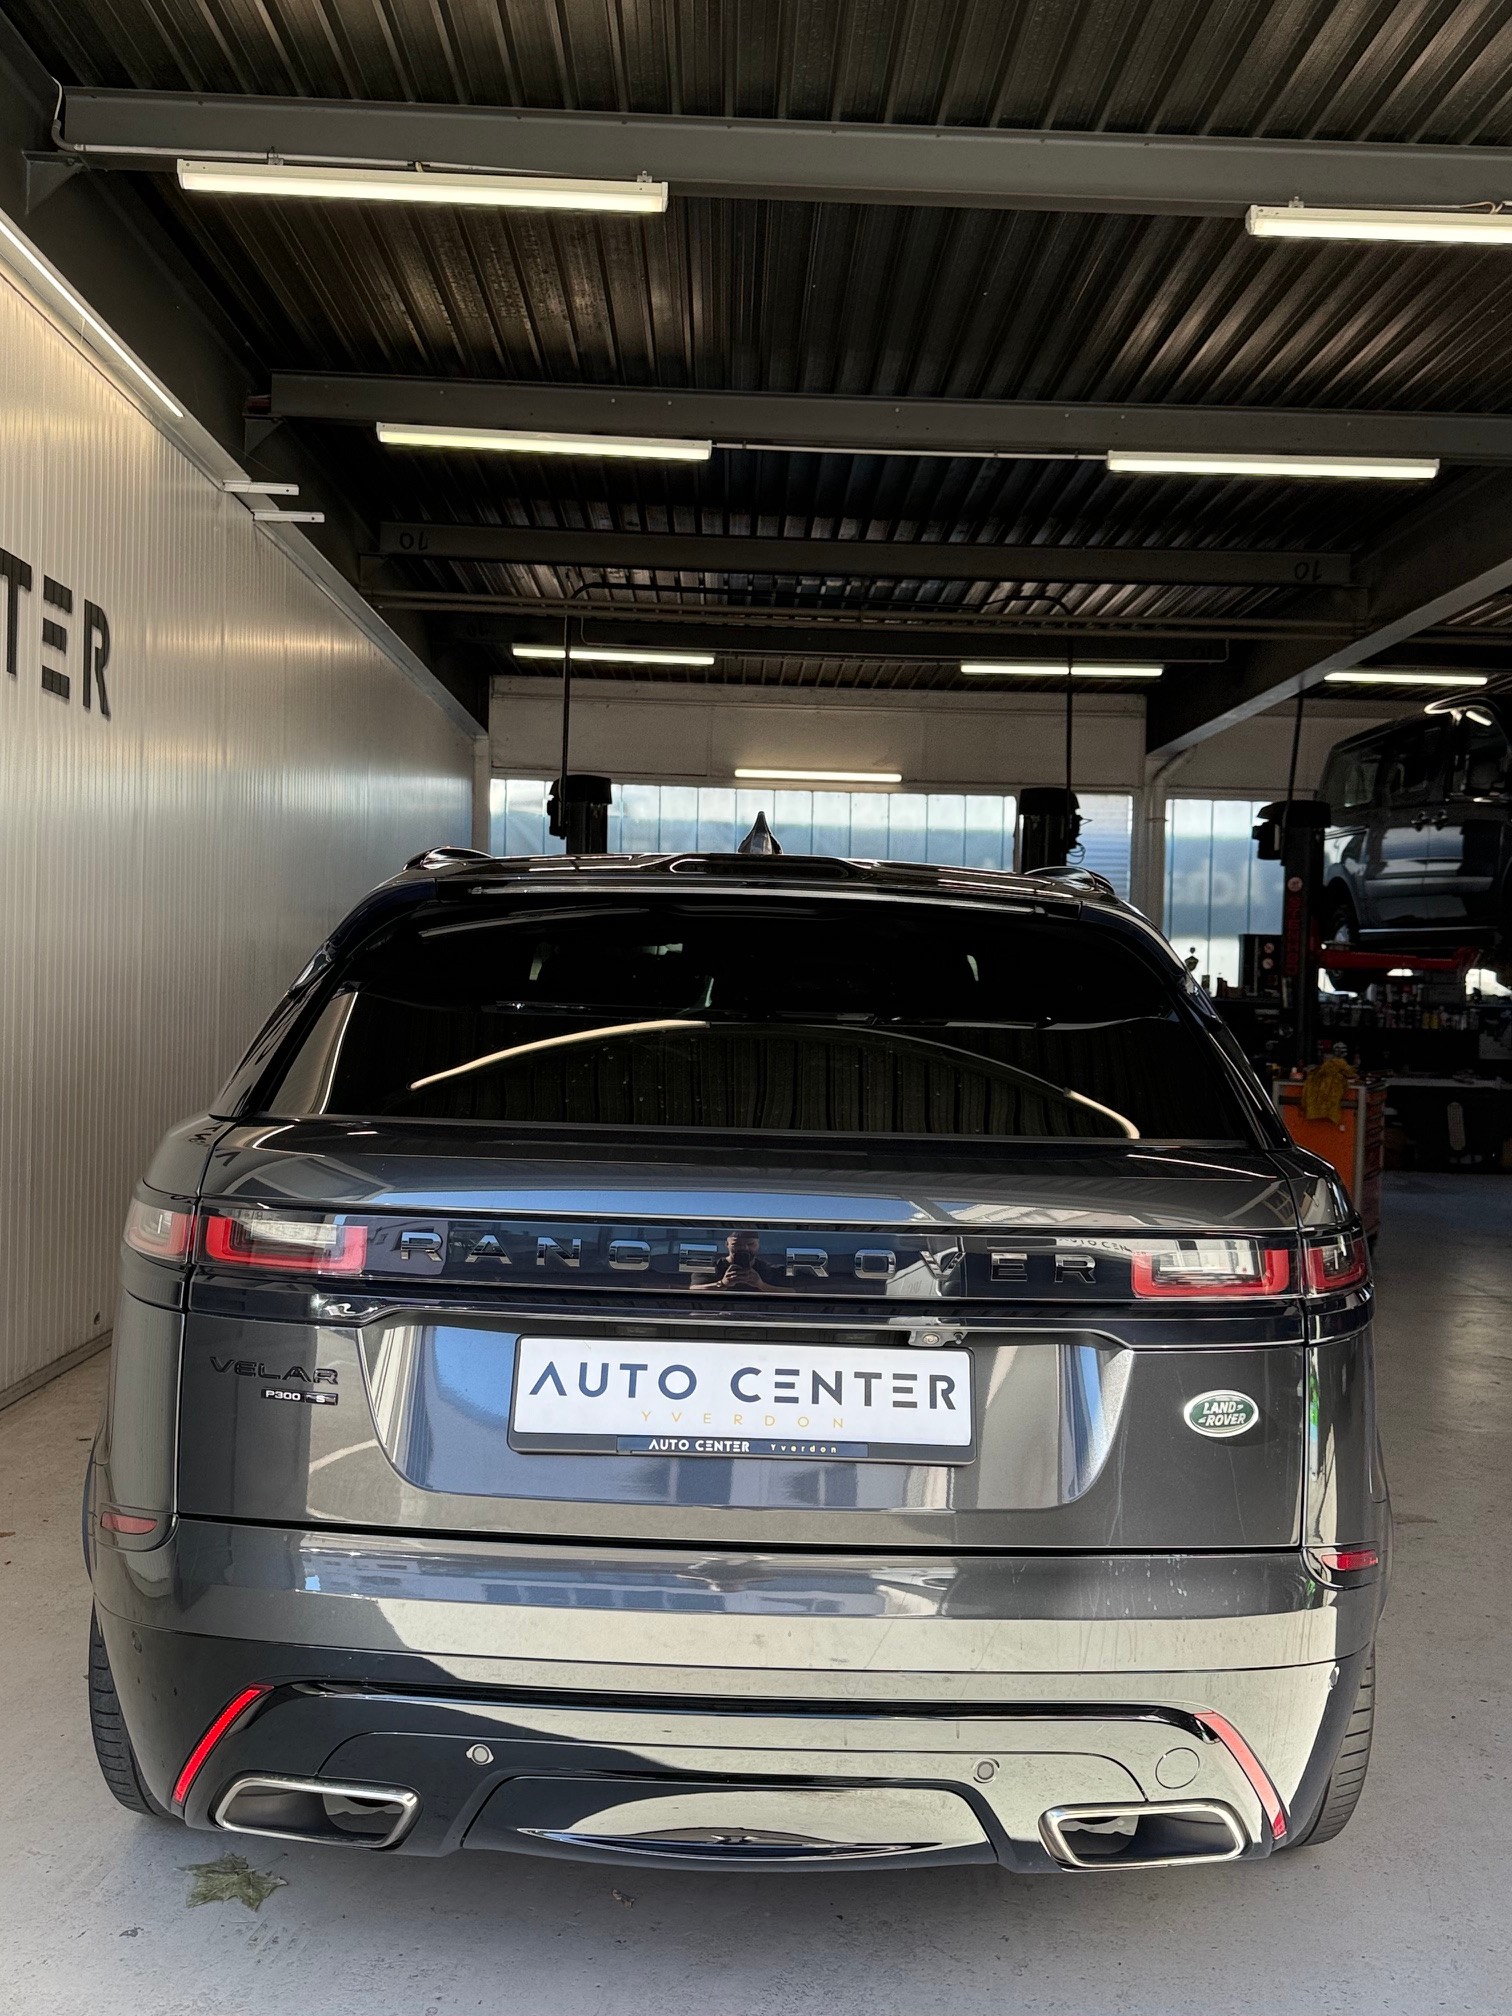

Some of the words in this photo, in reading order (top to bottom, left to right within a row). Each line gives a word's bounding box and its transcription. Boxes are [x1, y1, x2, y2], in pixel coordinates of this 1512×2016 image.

[0, 547, 110, 717] TER
[400, 1231, 718, 1273] RANGE
[785, 1247, 1096, 1284] ROVER
[209, 1356, 339, 1385] VELAR
[529, 1360, 697, 1401] AUTO
[730, 1367, 957, 1411] CENTER
[265, 1389, 301, 1401] P300
[1203, 1401, 1237, 1415] LAND
[642, 1411, 844, 1429] YVERDON
[1205, 1413, 1246, 1426] ROVER
[648, 1438, 690, 1451] AUTO
[695, 1439, 750, 1453] CENTER
[770, 1443, 837, 1453] Yverdon
